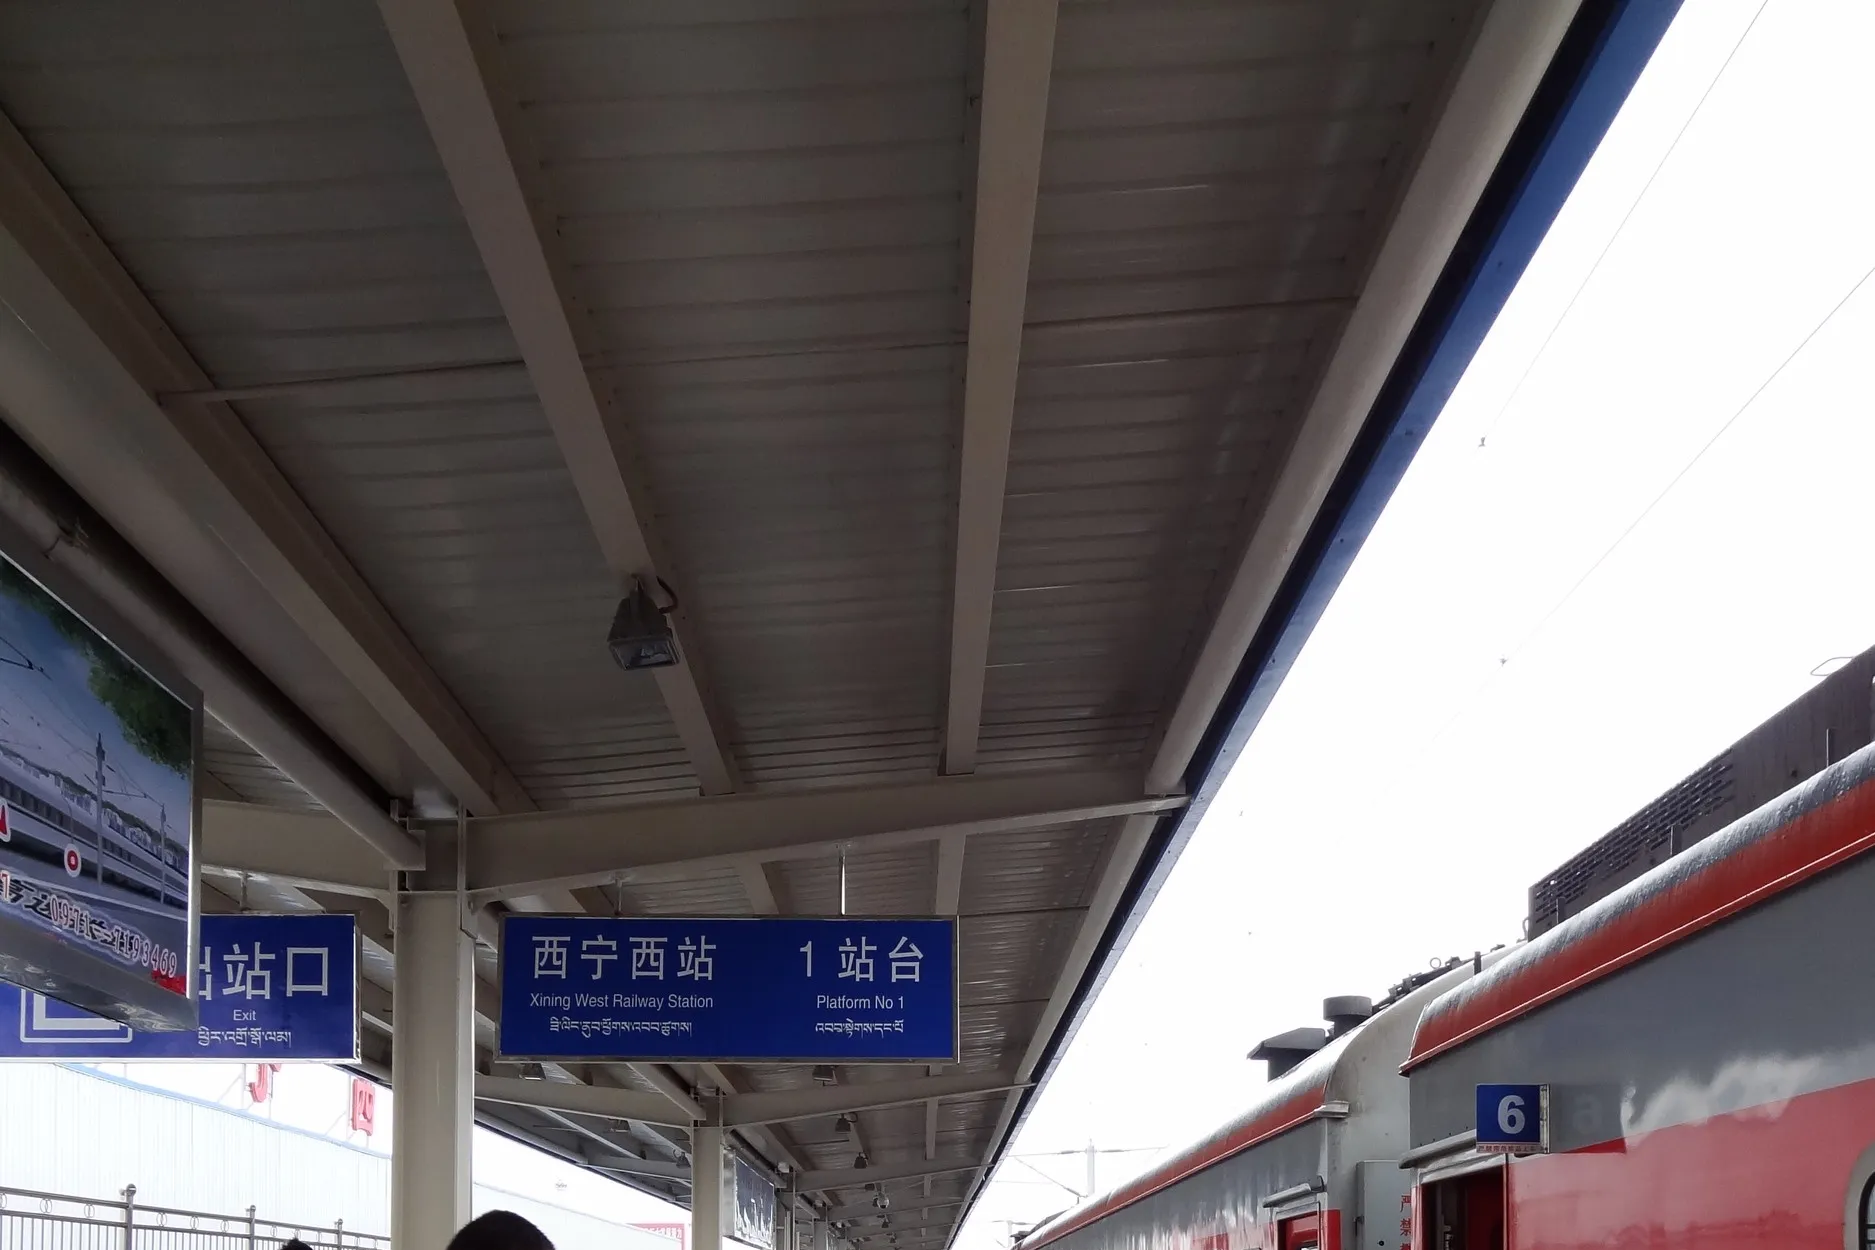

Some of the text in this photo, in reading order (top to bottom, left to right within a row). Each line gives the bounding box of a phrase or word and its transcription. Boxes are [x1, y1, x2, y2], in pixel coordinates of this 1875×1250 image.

[532, 935, 716, 980] 西宁西站
[530, 993, 713, 1011] Xining West Railway Station
[817, 995, 904, 1009] Platform No 1
[233, 1010, 257, 1021] Exit
[1498, 1095, 1525, 1134] 6
